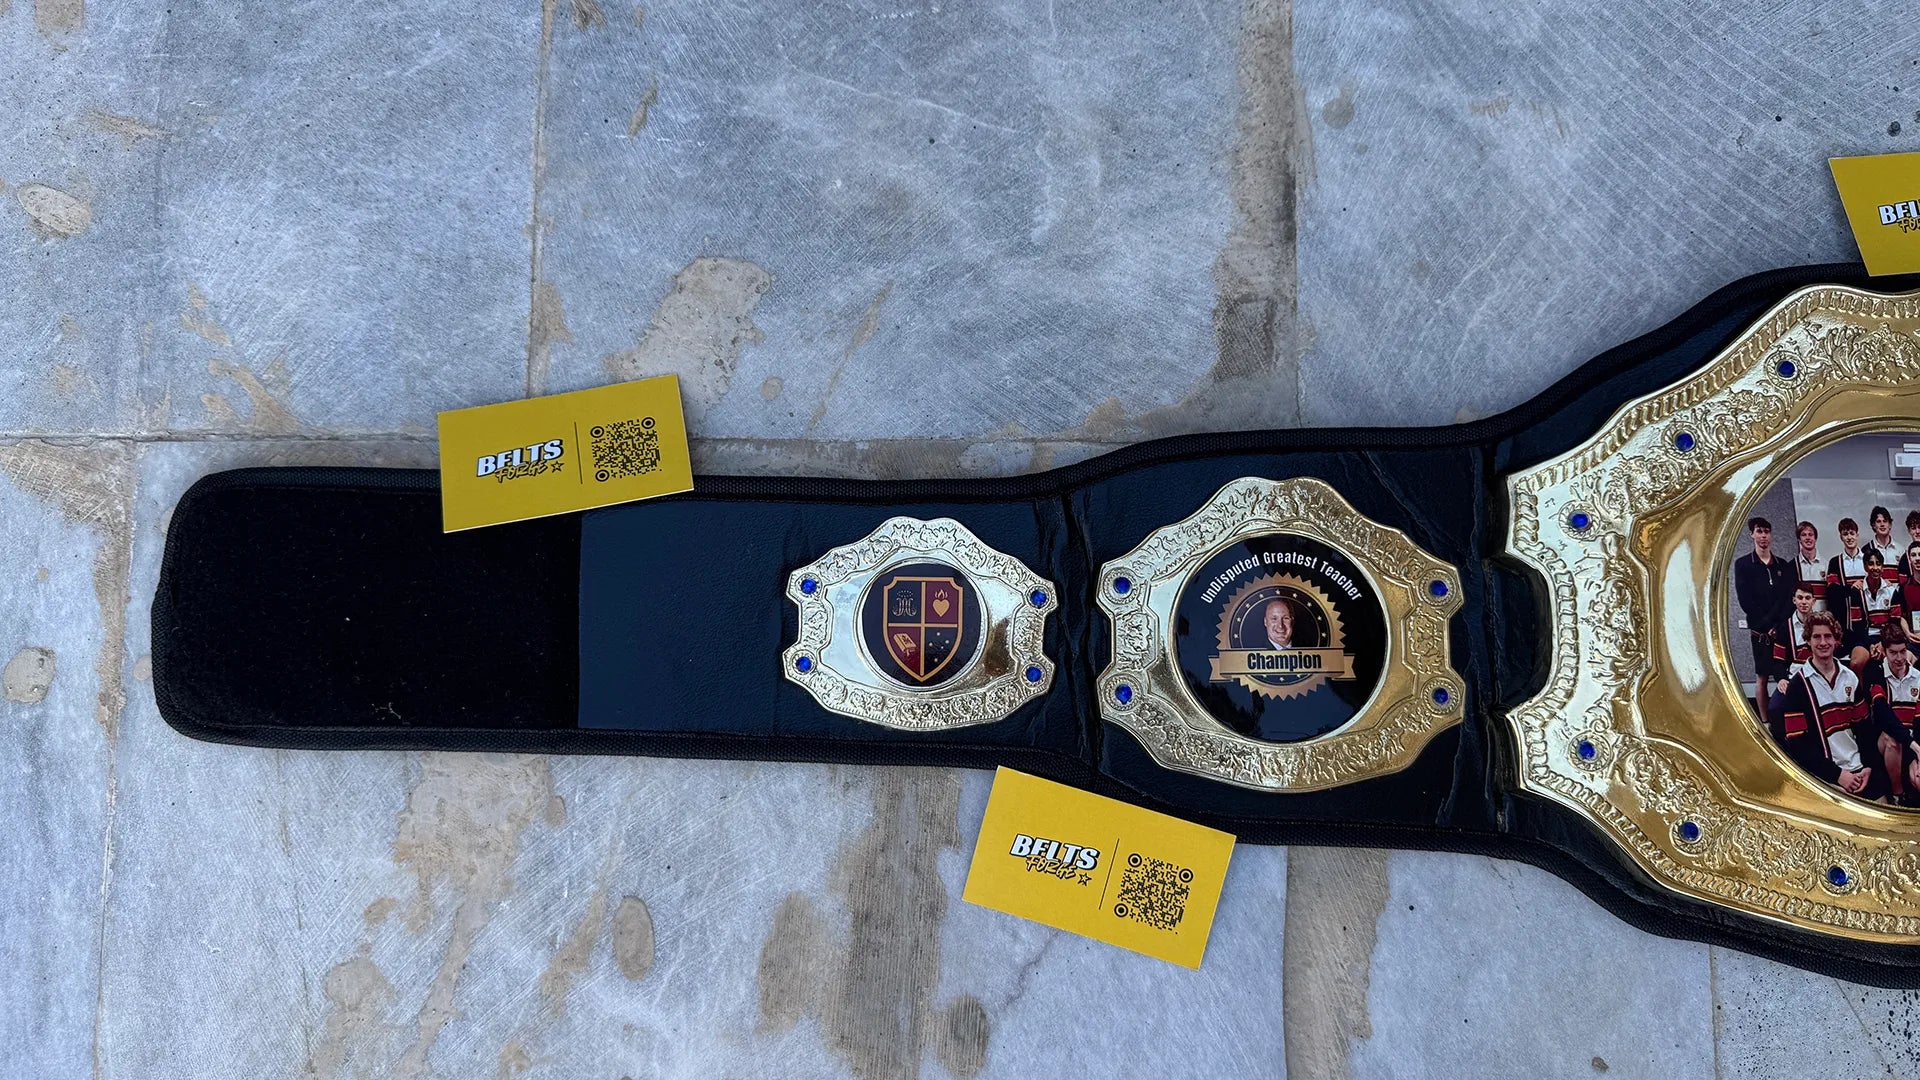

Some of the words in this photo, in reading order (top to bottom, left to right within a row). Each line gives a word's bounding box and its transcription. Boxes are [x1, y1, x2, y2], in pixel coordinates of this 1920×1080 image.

[1878, 199, 1920, 225] BEL
[477, 438, 564, 477] BELTS
[495, 460, 548, 483] FORGE
[1263, 551, 1318, 570] Greatest
[1320, 561, 1363, 600] Teacher
[1247, 652, 1322, 672] Champion
[1009, 833, 1100, 871] BELTS
[1026, 855, 1077, 880] FORGE
